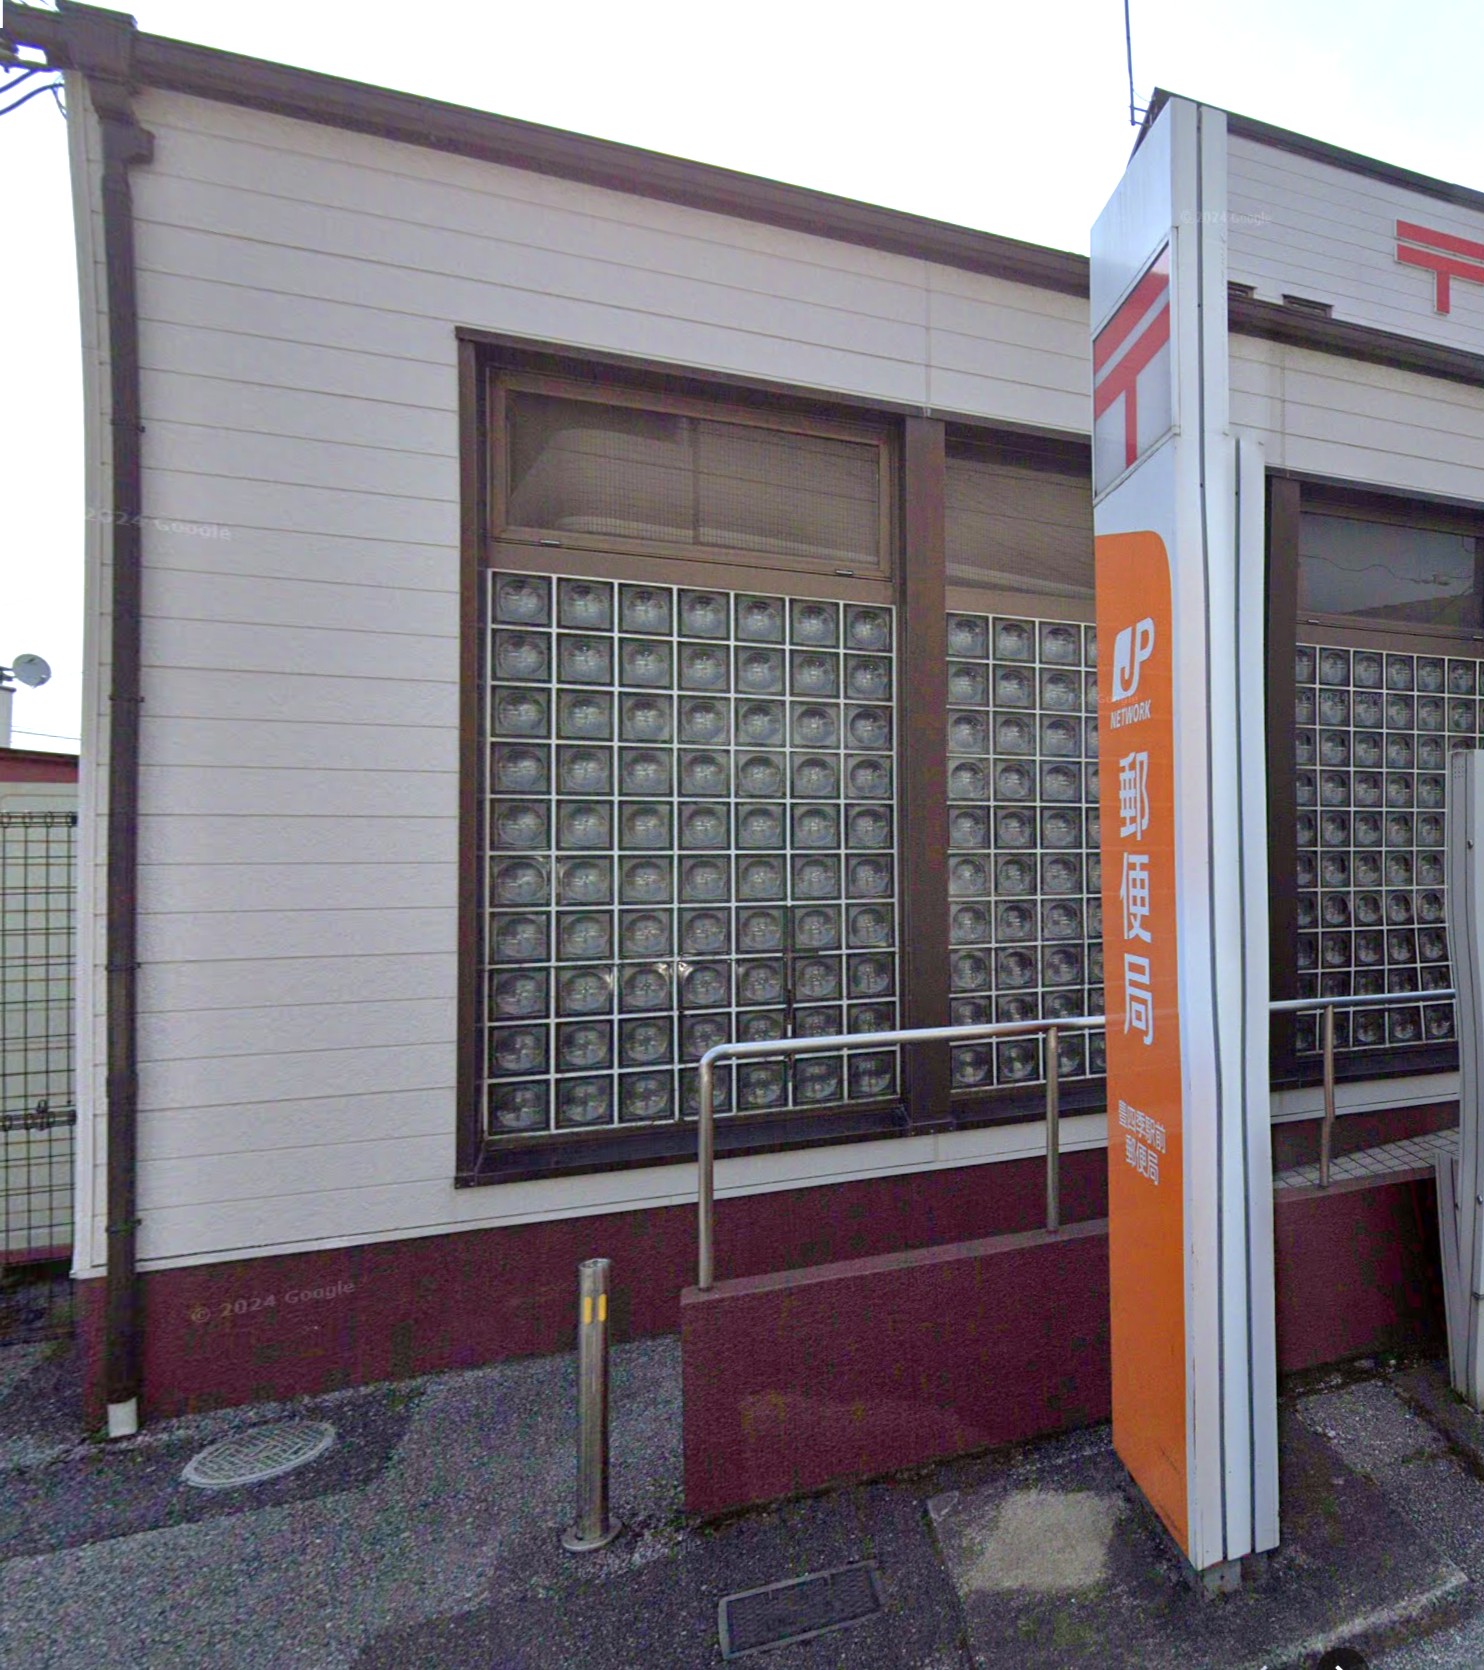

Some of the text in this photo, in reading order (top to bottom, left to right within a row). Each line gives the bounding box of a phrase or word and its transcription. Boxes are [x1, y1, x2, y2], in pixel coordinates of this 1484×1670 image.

[1110, 698, 1153, 731] NETWORK
[1118, 750, 1155, 1046] 郵便局
[1125, 1133, 1160, 1186] 郵便局
